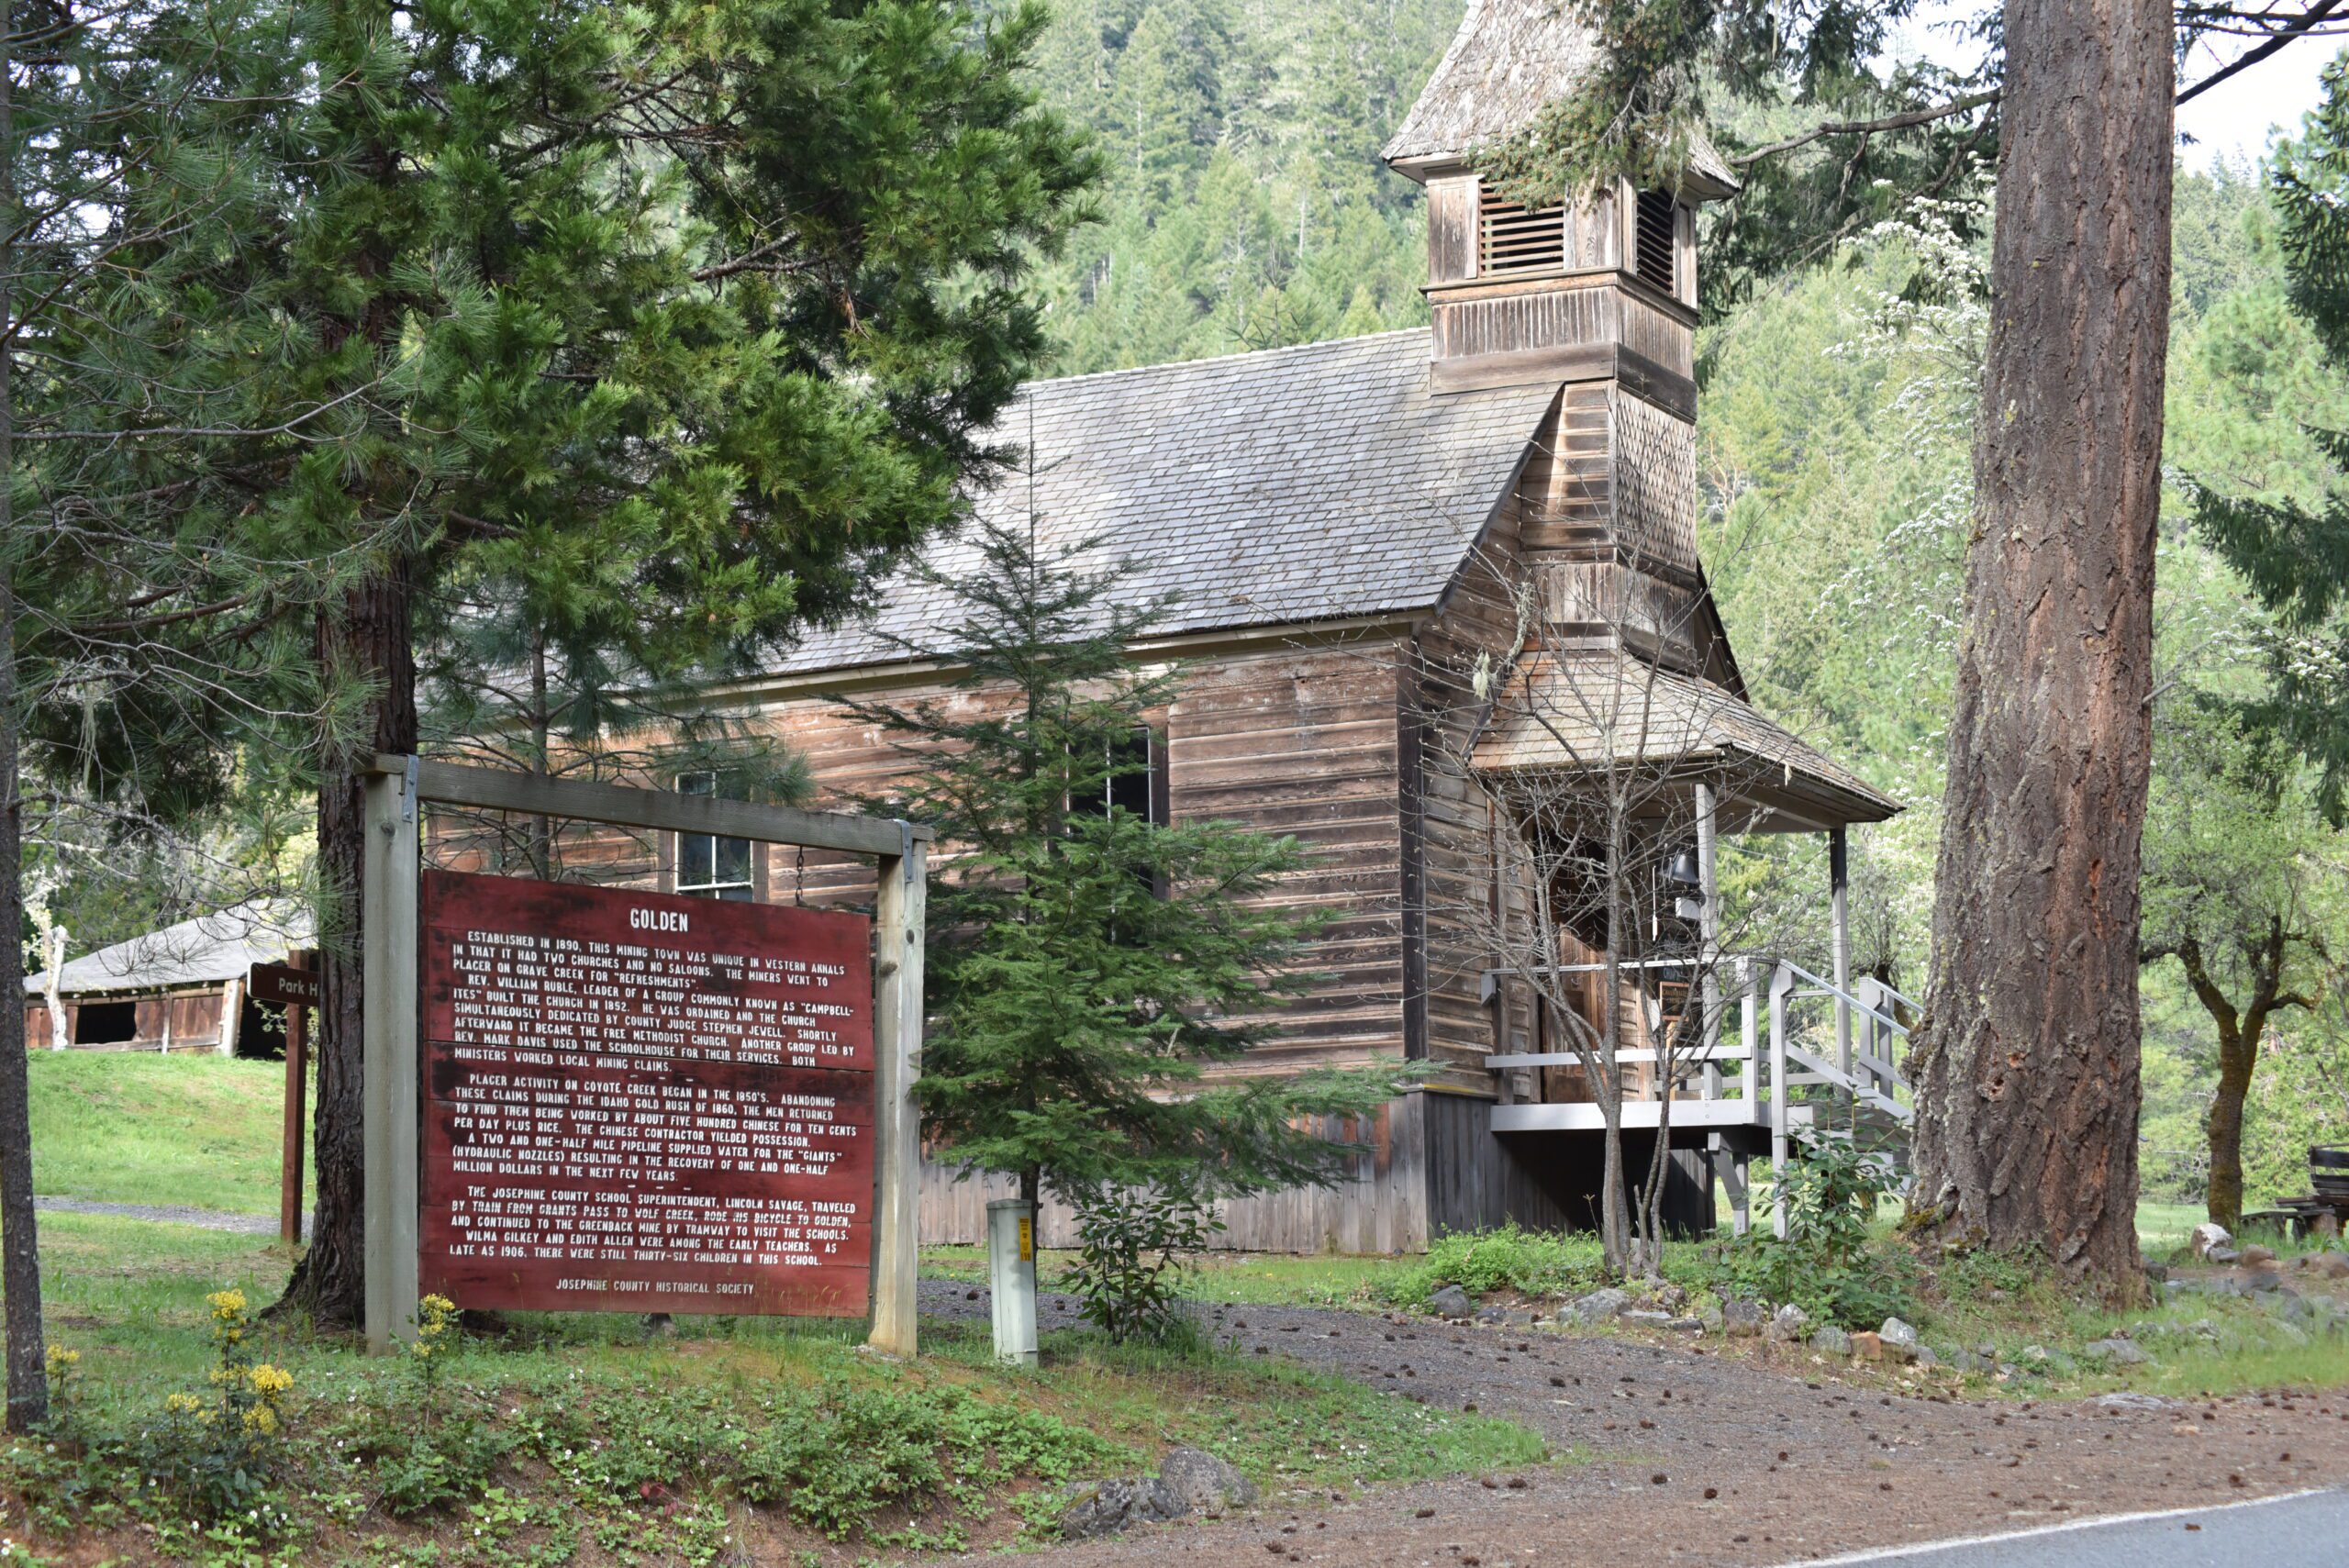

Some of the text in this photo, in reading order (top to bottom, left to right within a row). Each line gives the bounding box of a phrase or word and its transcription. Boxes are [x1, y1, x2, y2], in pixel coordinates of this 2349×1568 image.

[630, 908, 688, 932] GOLDEN
[468, 931, 844, 975] ESTABLISHED THIS MINING TOWN WAS UNIQUE WESTERN ANNALS
[470, 945, 809, 985] THAT HAD TWO CHURCHES SALOONS. MINERS WENT
[453, 959, 607, 982] PLACER GRAVE CREEK FOR
[279, 977, 305, 995] Park
[497, 977, 777, 1010] WILLIAM RUBLE, LEADER GROUP COMMONLY KNOWN
[454, 1002, 836, 1041] SIMULTANEOUSLY DEDICATED COUNTY JUDGE STEPHEN JEWELL. SHORTLY
[486, 991, 816, 1027] BUILT CHURCH WAS ORDAINED CHURCH
[455, 1017, 838, 1055] AFTERWARD BECAME FREE METHODIST CHURCH. ANOTHER GROUP LED
[484, 1033, 815, 1067] MARK DAVIS USED SCHOOLHOUSE FOR THEIR BOTH
[454, 1048, 672, 1072] MINISTERS WORKED LOCAL MINING CLAIMS.
[455, 1086, 833, 1120] THESE CLAIMS DURING IDAHO GOLD RUSH MEN RETURNED
[470, 1073, 835, 1107] PLACER ACTIVITY COYOTE CREEK BEGAN ABANDONING
[454, 1117, 810, 1147] PER DAY PLUS CHINESE CONTRACTOR YIELDED POSSESSION.
[535, 1107, 856, 1137] BEING WORKED ABOUT FIVE HUNDRED CHINESE FOR TEN CENTS
[452, 1145, 829, 1175] (HYDRAULIC NOZZLES) RESULTING RECOVERY ONE ONE-HALF
[483, 1133, 771, 1159] TWO ONE-HALF MILE PIPELINE SUPPLIED WATER FOR
[453, 1161, 639, 1179] MILLION DOLLARS NEXT FEW
[468, 1185, 855, 1214] THE JOSEPHINE COUNTY SCHOOL SUPERINTENDENT, LINCOLN SAVAGE, TRAVELED
[473, 1201, 851, 1228] TRAIN FROM GRANTS PASS WOLF CREEK, RODE BICYCLE GOLDEN,
[477, 1216, 849, 1240] CONTINUED GREENBACK MINE TRAMWAY VISIT SCHOOLS.
[450, 1244, 822, 1265] LATE THERE WERE STILL THIRTY-SIX CHILDREN THIS SCHOOL.
[466, 1230, 812, 1251] WILMA GILKEY EDITH ALLEN WERE AMONG EARLY TEACHERS.
[556, 1279, 753, 1294] JOSEPHINE COUNTY HISTORICAL SOCIETY
